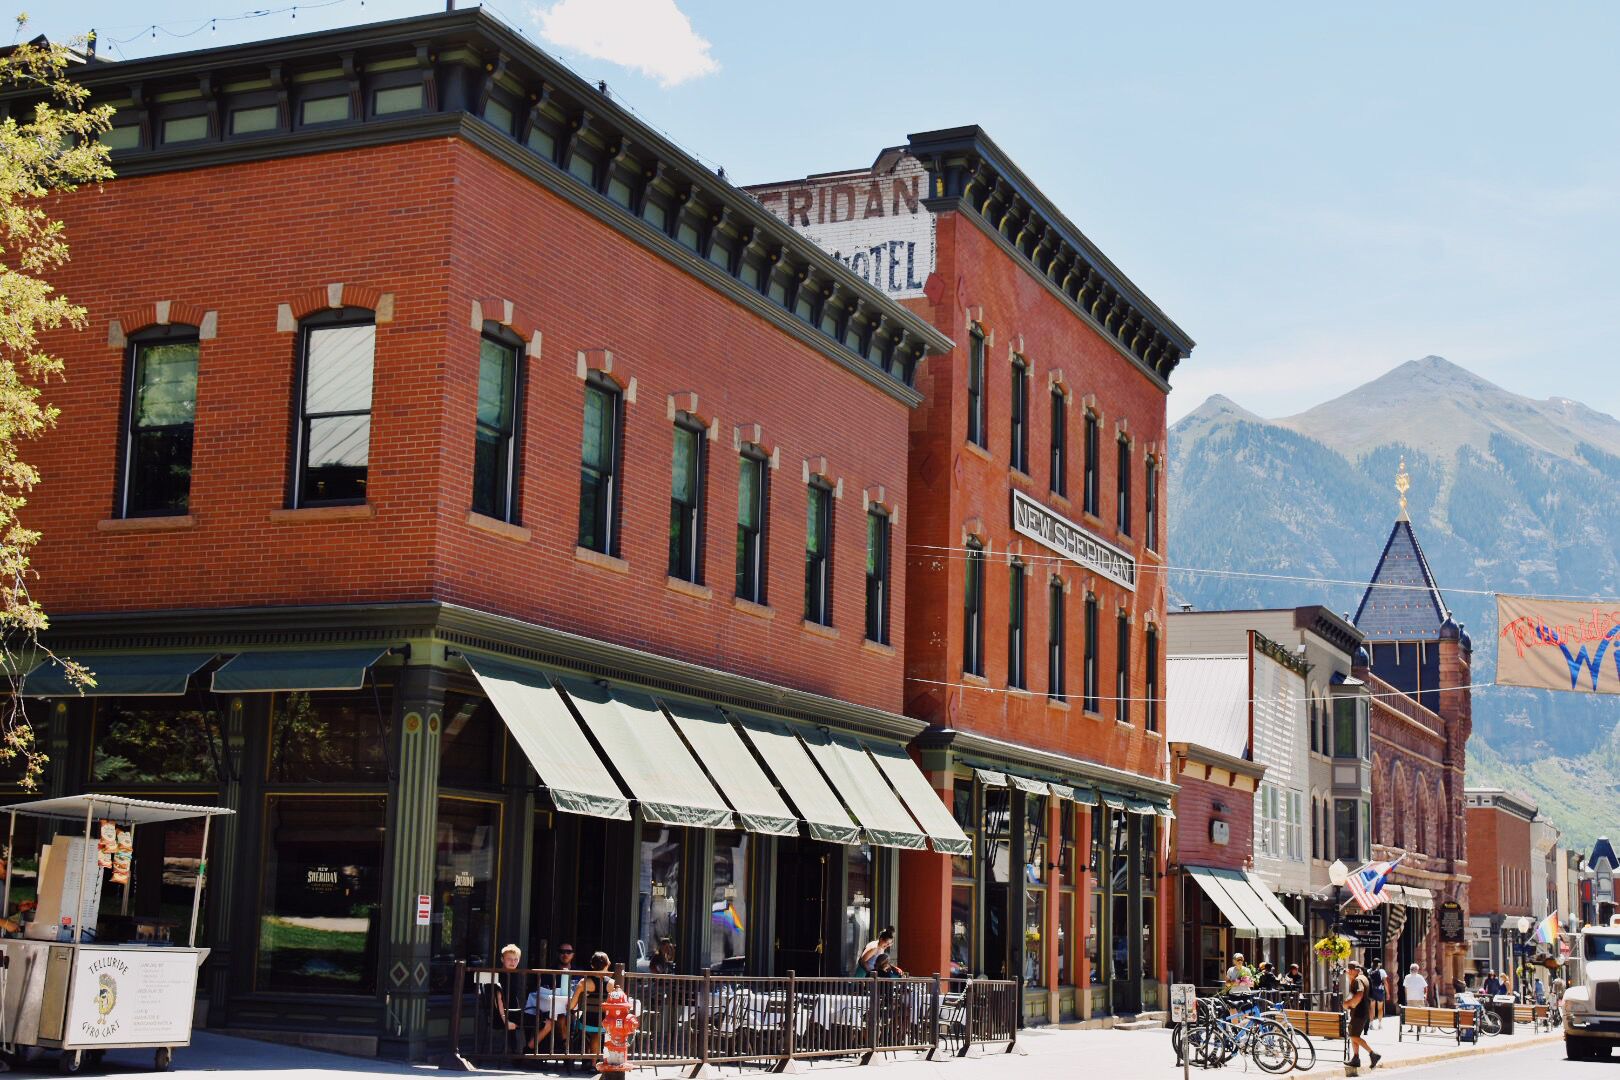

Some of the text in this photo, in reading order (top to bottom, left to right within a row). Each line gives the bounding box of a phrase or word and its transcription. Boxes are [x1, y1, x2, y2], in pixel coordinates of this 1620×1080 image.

[1015, 500, 1131, 583] NEW SHERIDAN
[88, 956, 129, 975] TELLURIDE
[82, 1020, 120, 1038] GYRO CART
